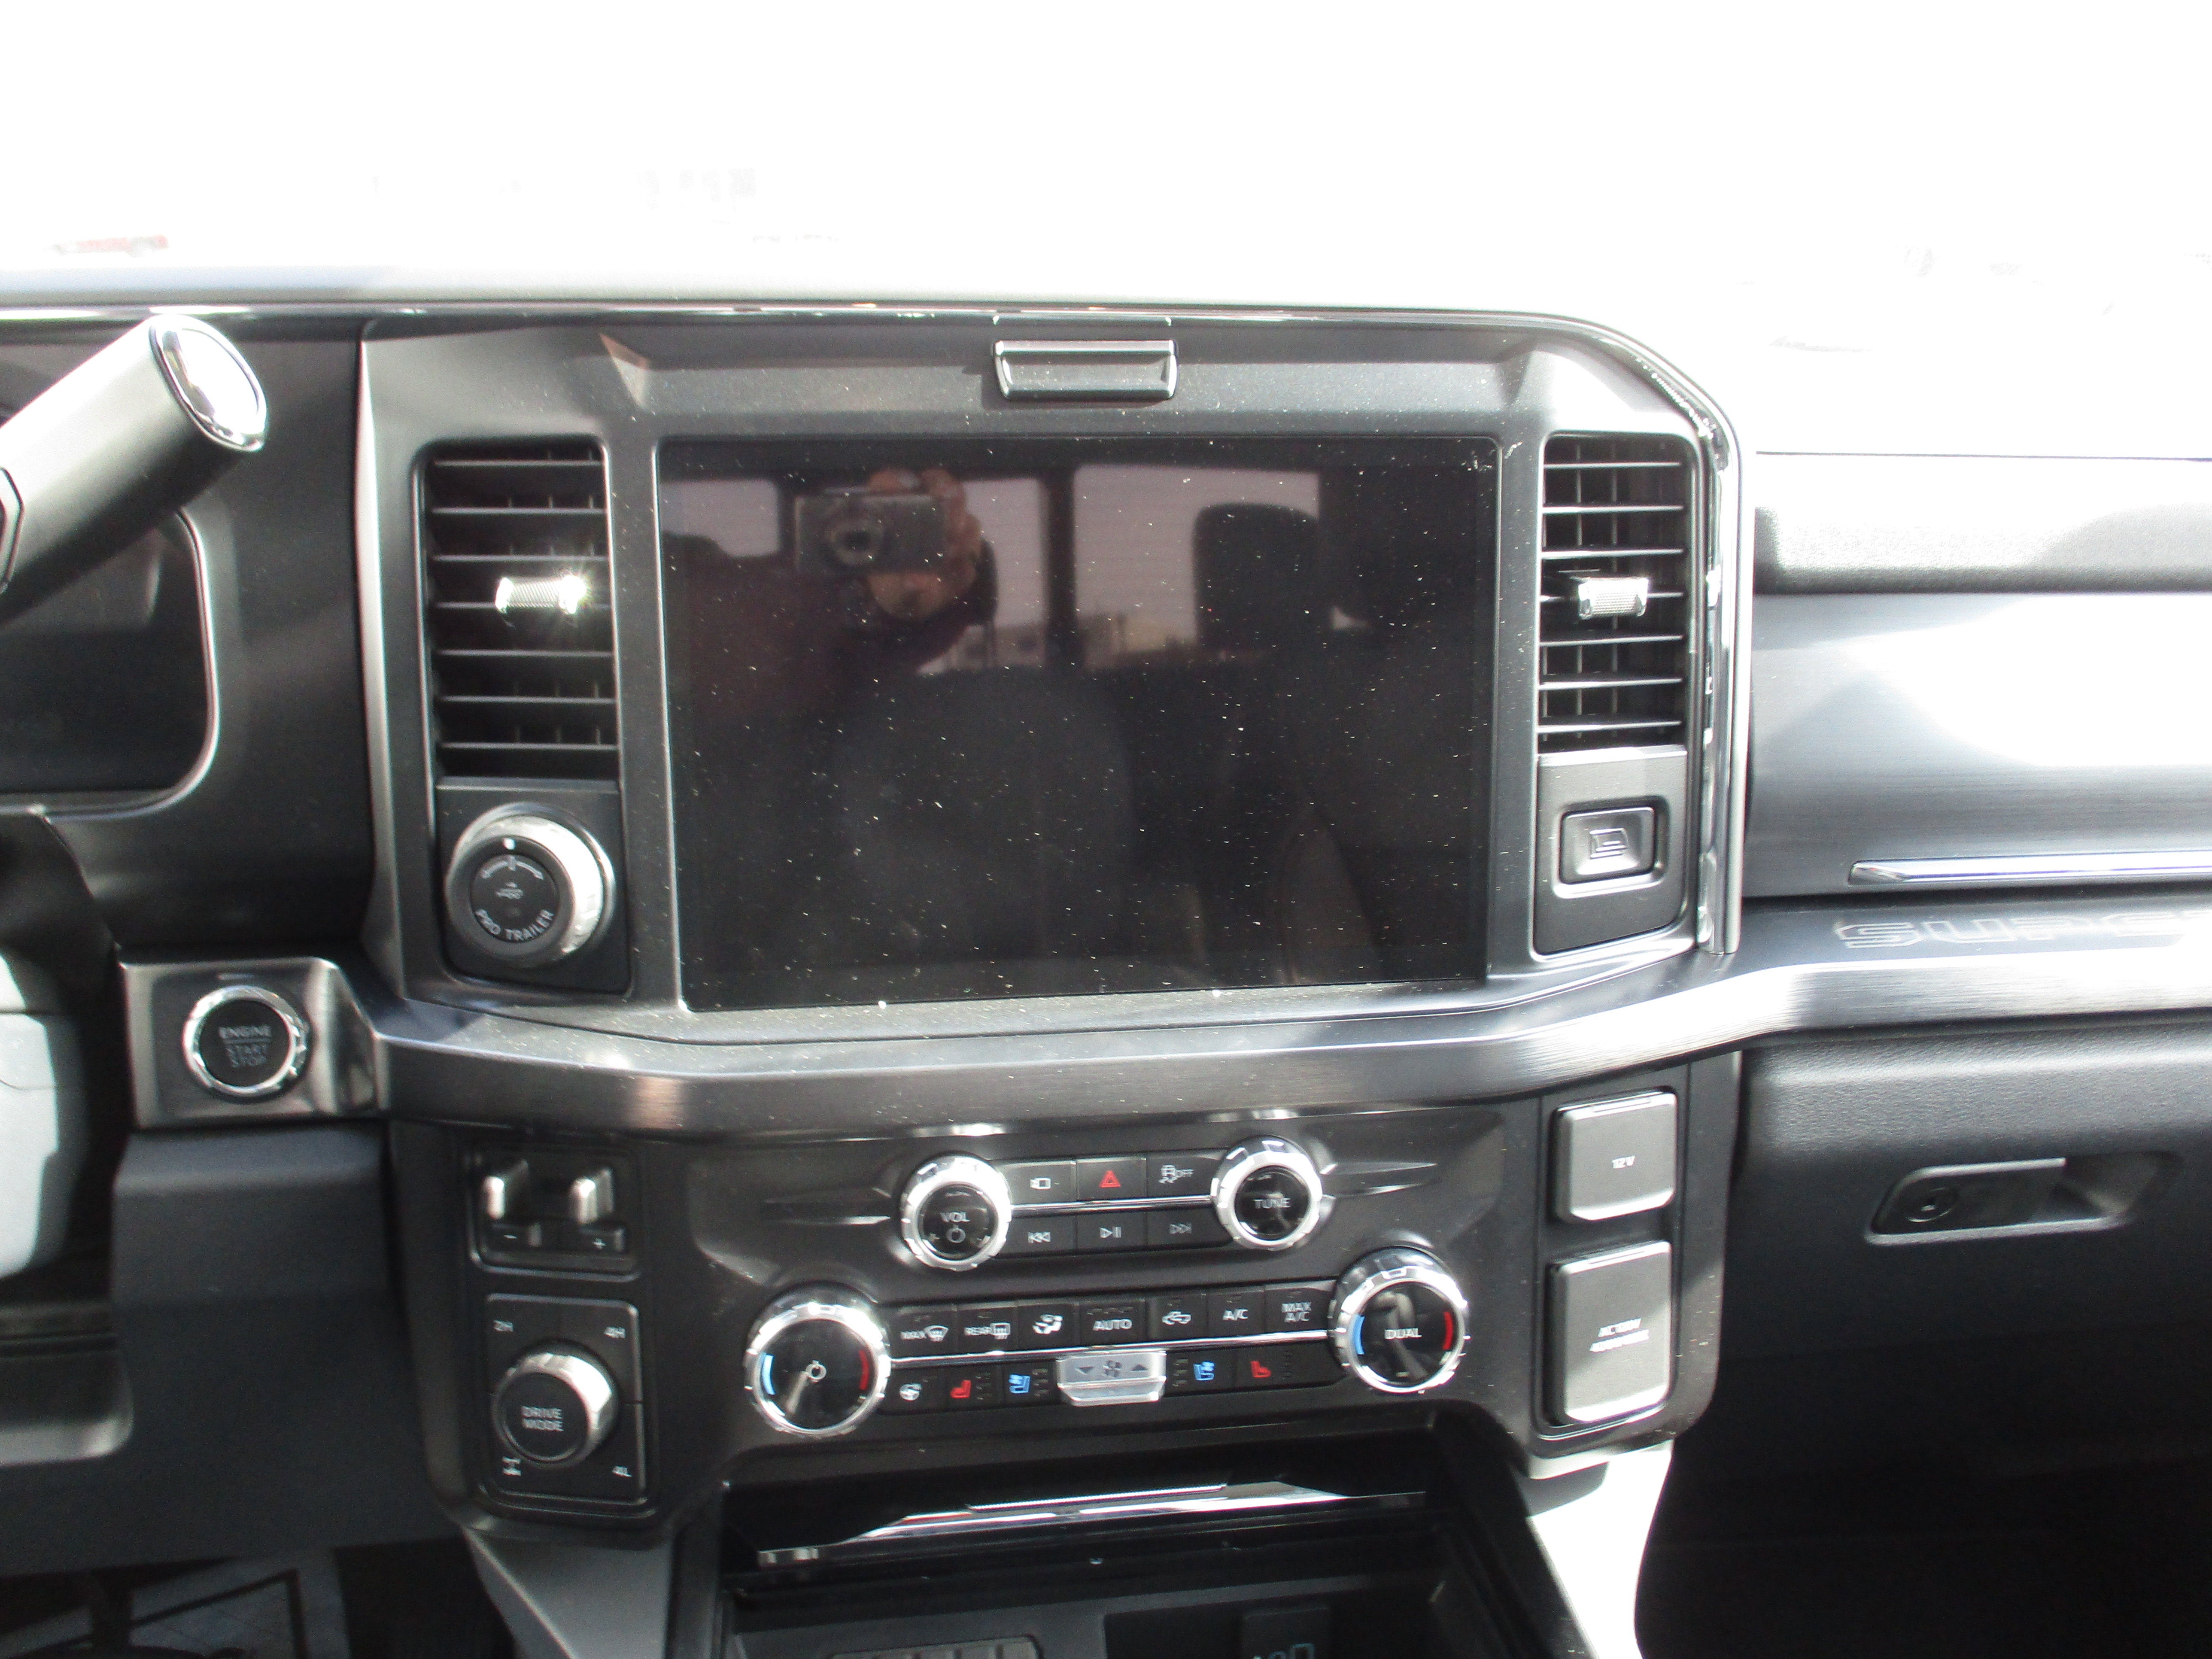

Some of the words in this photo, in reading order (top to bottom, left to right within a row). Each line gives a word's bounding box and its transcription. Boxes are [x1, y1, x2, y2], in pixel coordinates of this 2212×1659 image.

[504, 909, 554, 941] TRAILER
[1254, 1197, 1291, 1209] TUNE
[940, 1211, 970, 1223] VOL
[1282, 1301, 1312, 1313] MAX
[1222, 1308, 1249, 1322] A/C
[1284, 1311, 1310, 1323] A/C
[1093, 1319, 1133, 1331] AUTO
[1384, 1328, 1422, 1340] DUAL
